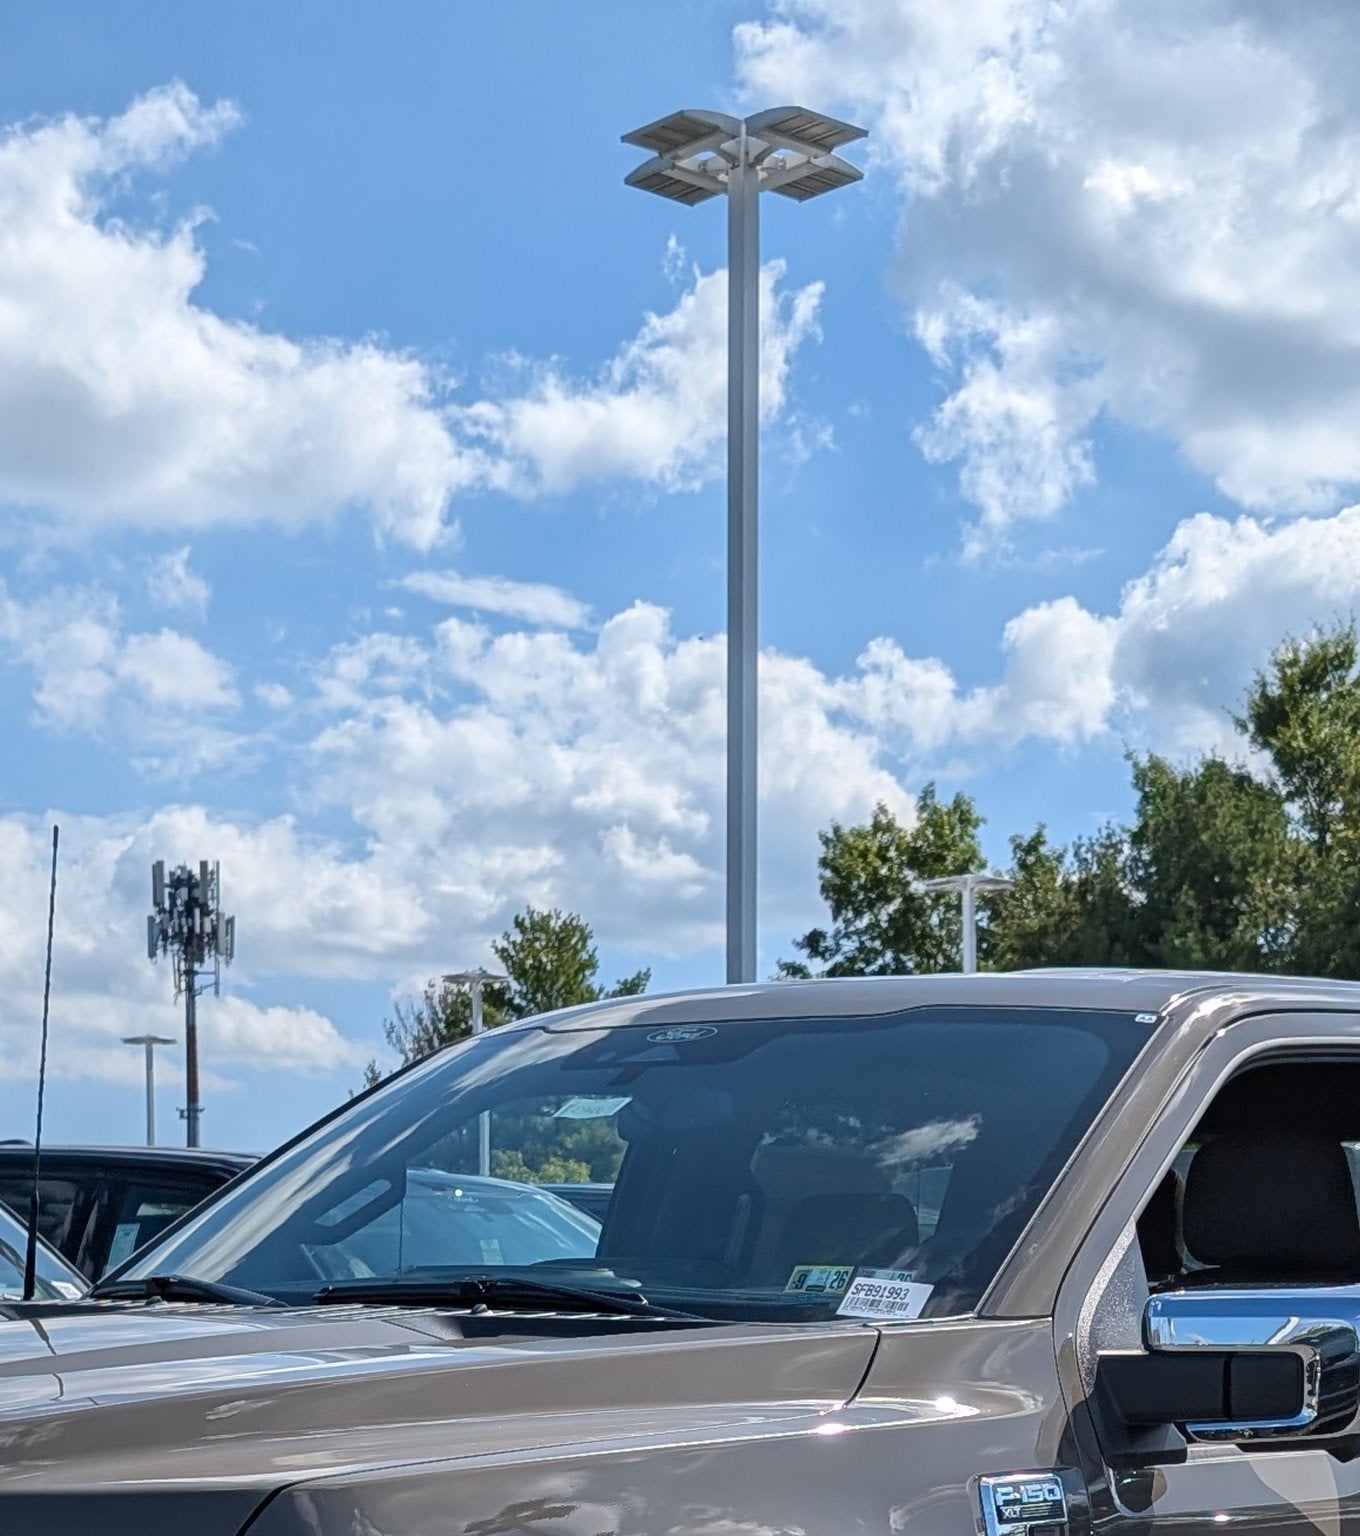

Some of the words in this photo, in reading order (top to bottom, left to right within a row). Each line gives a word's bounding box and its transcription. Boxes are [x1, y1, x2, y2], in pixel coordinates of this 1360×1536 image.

[829, 1270, 849, 1290] 26
[851, 1282, 910, 1301] SFB91993
[996, 1483, 1062, 1506] F-150
[1001, 1507, 1020, 1520] XLT
